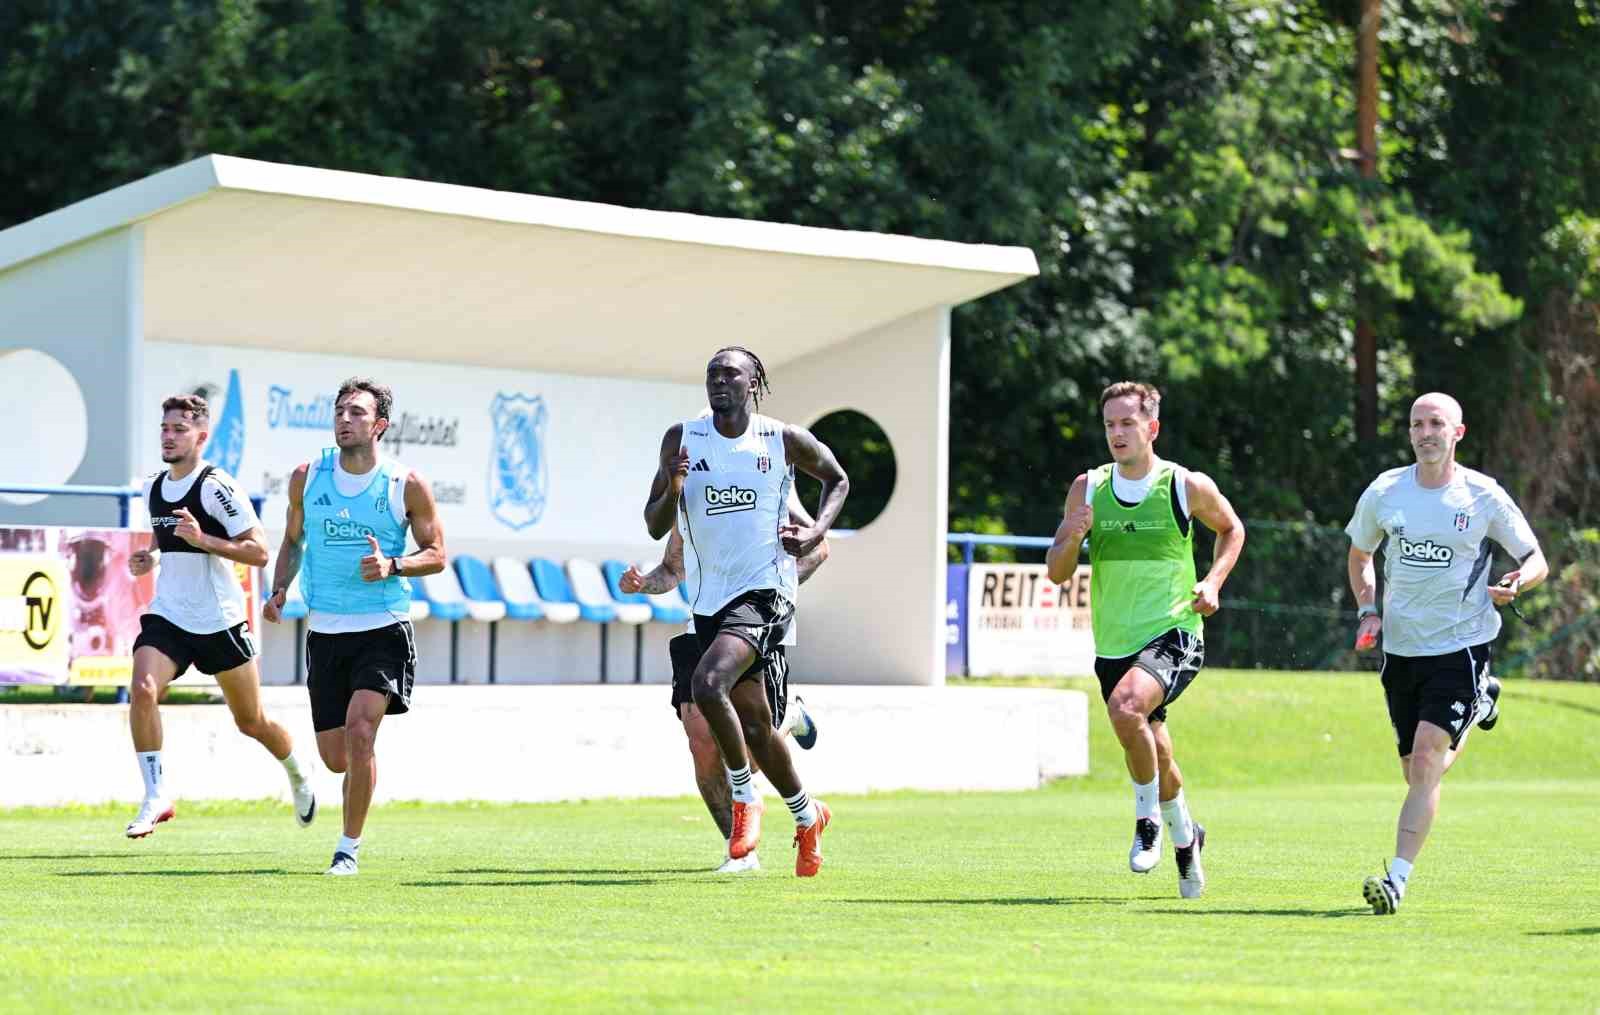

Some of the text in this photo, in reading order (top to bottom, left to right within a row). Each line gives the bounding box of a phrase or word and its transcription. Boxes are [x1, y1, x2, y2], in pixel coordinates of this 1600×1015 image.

[214, 488, 239, 518] misli
[705, 485, 757, 505] beko
[324, 518, 376, 538] beko
[1400, 537, 1454, 562] beko
[25, 597, 53, 631] TV
